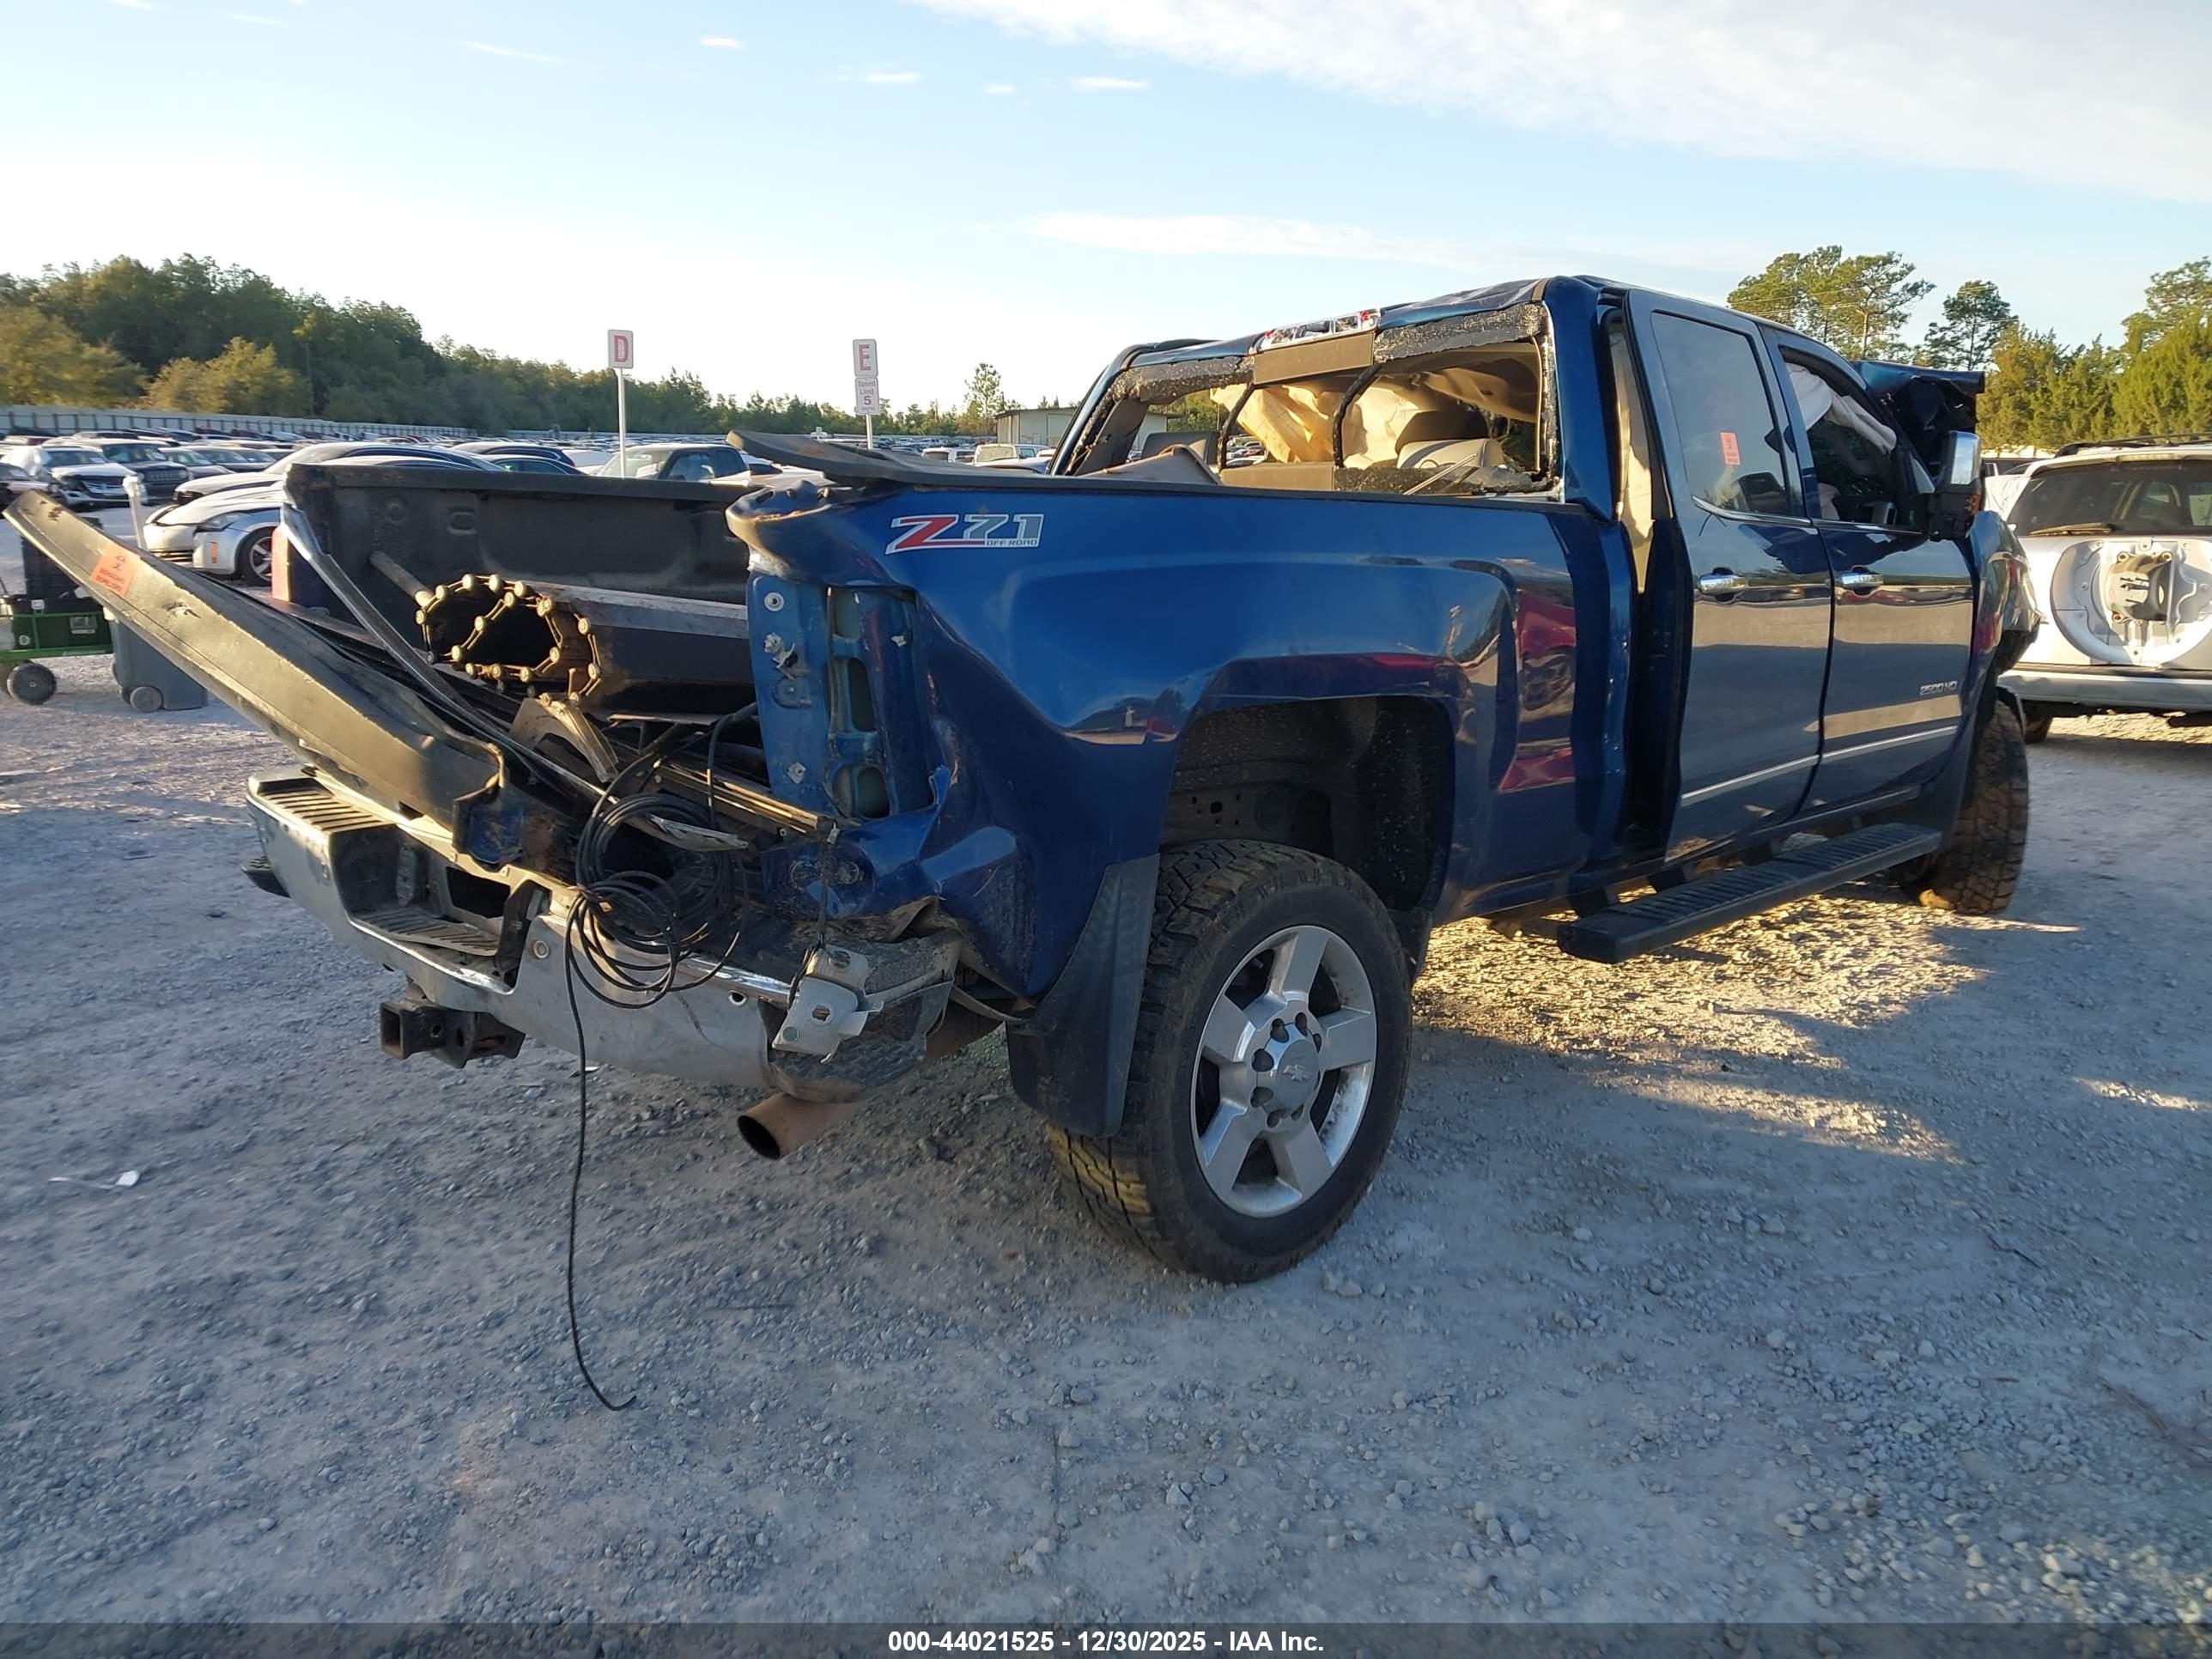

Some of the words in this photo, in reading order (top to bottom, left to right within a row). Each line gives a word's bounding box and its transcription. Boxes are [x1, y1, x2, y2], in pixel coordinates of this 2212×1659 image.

[613, 335, 629, 362] D
[859, 343, 872, 371] E
[864, 395, 872, 405] 5
[884, 514, 1045, 556] Z71
[1919, 683, 1944, 696] 2500
